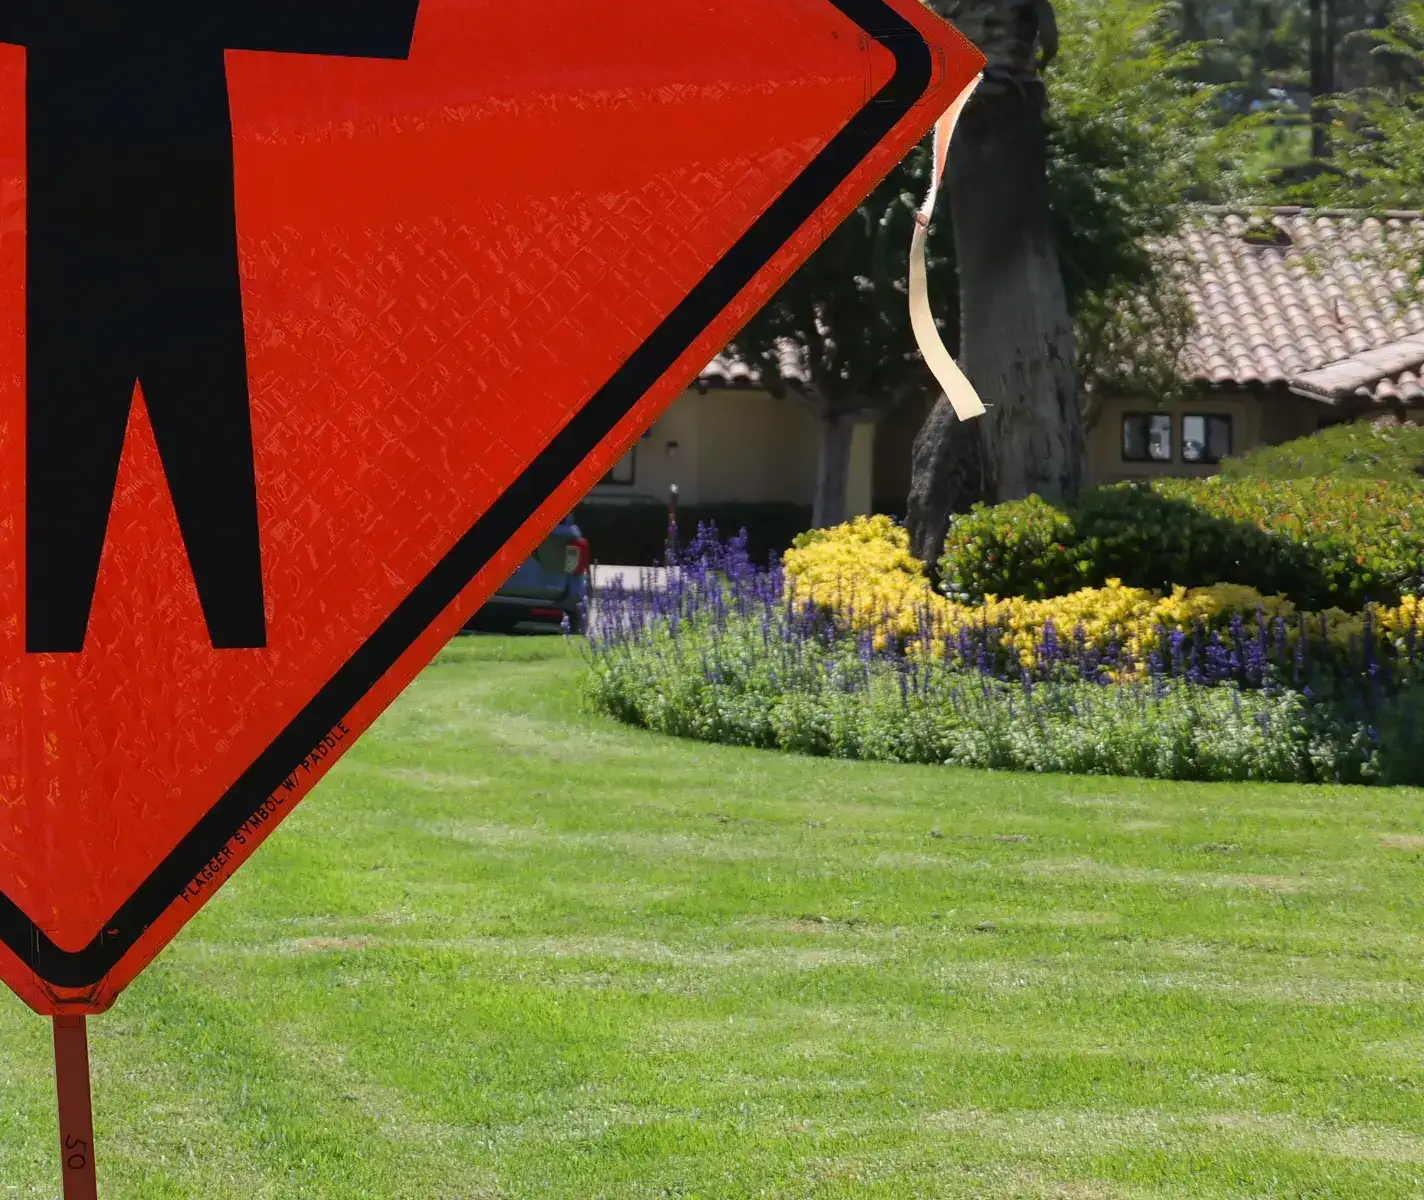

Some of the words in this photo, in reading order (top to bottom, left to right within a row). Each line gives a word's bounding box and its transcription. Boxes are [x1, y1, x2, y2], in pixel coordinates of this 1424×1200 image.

[179, 846, 234, 903] FLAGGER
[234, 795, 284, 845] SYMBOL
[282, 770, 300, 793] W/
[300, 721, 350, 774] PADDLE
